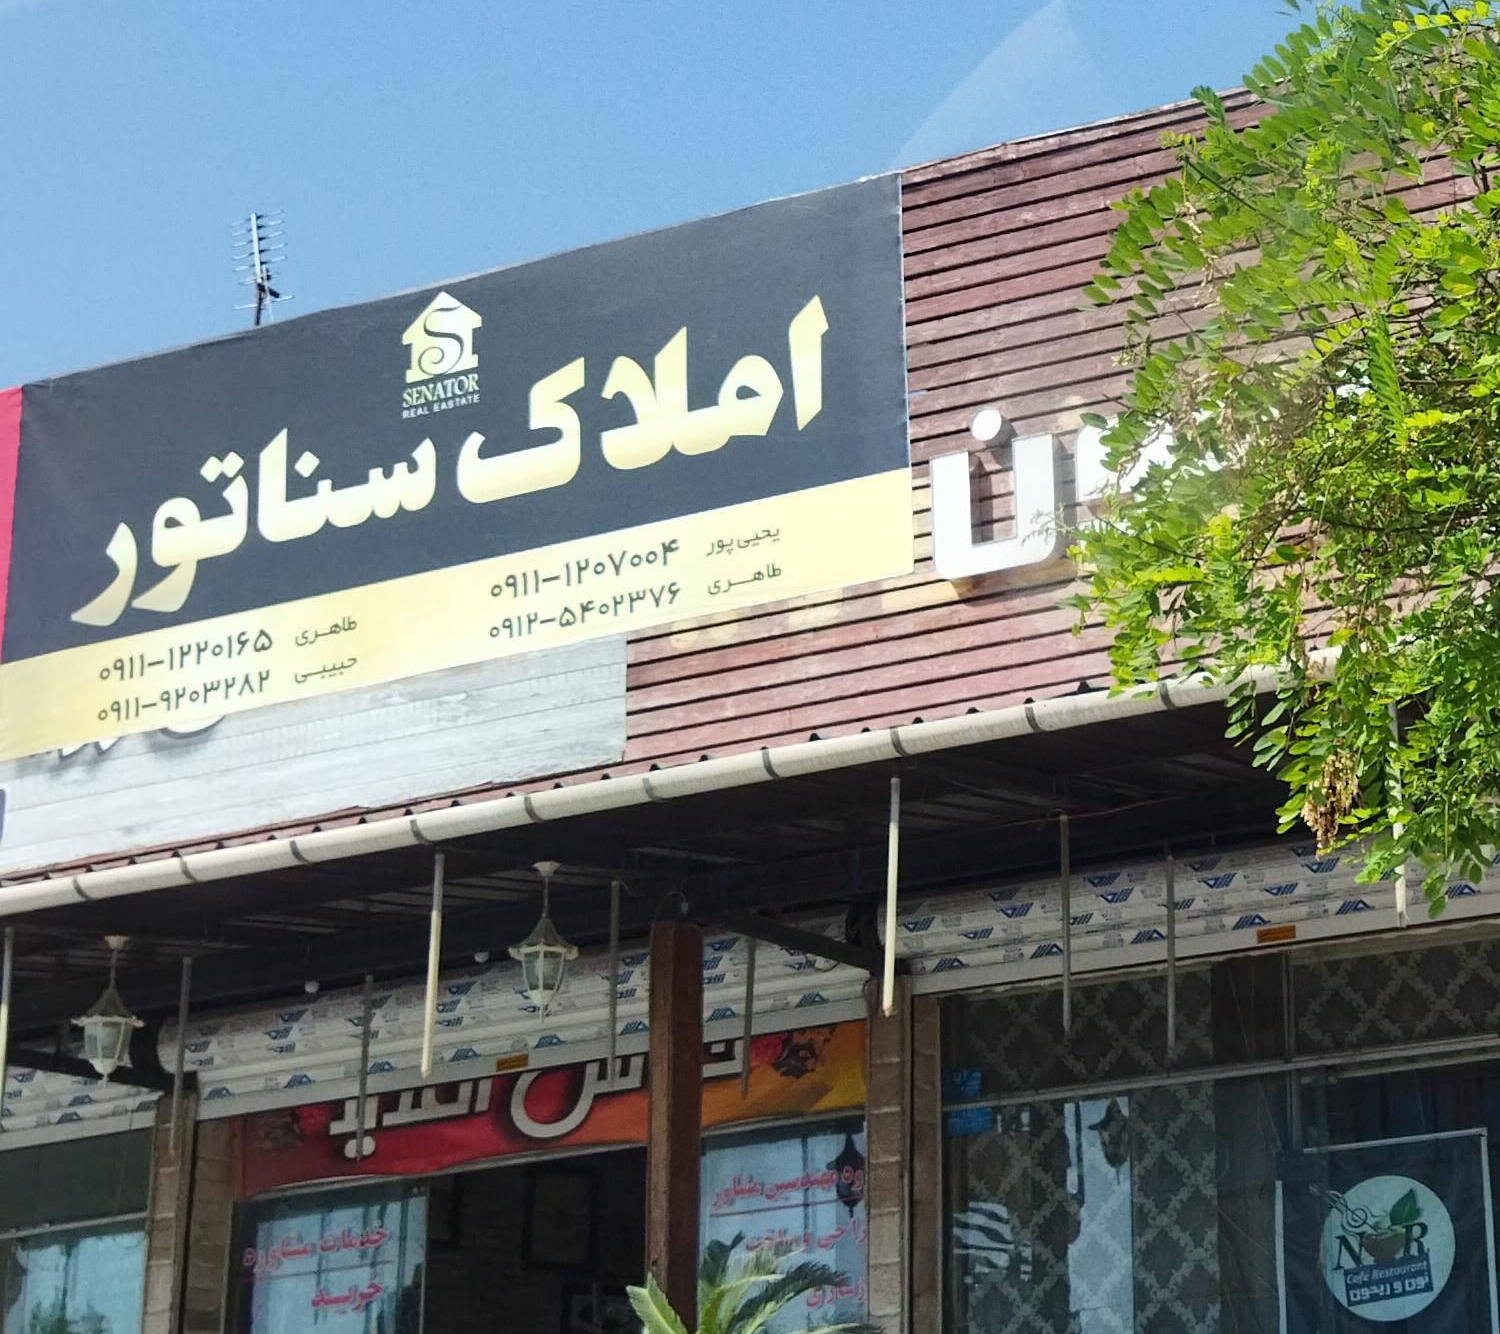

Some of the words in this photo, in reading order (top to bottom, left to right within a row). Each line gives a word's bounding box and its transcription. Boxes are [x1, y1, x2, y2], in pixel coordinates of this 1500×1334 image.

[402, 373, 480, 408] SENATOR
[402, 405, 430, 419] REAL
[433, 393, 481, 413] EASTATE
[456, 294, 828, 504] املاک
[72, 428, 435, 627] سناتور
[490, 538, 681, 598] ۰۹۱۱-۱۲۰۷۰۰۴
[489, 581, 682, 639] ۰۹۱۲-۵۴۰۲۳۷۶
[98, 628, 274, 681] ۰۹۱۱-۱۲۲۰۱۶۵
[96, 669, 271, 722] ۰۹۱۱-۹۲۰۳۲۸۲
